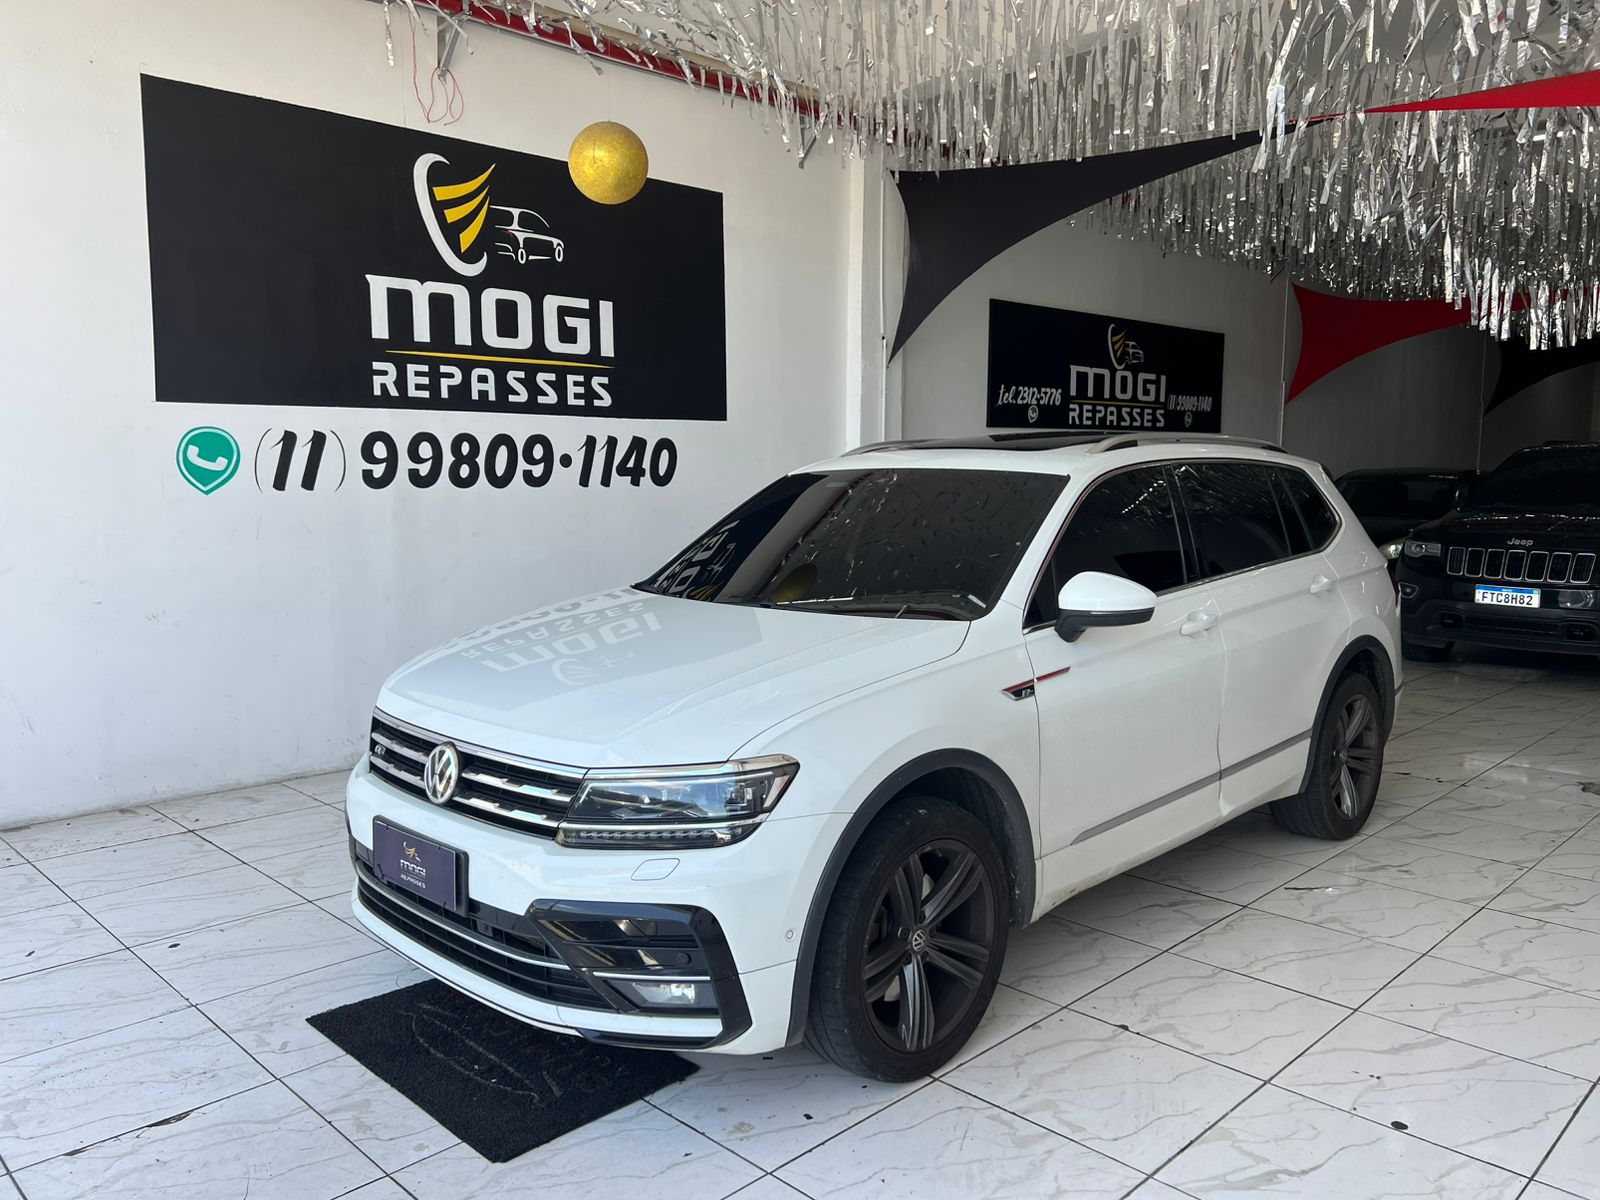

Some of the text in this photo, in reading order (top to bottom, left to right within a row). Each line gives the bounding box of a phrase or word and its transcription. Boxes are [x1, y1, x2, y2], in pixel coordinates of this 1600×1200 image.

[365, 274, 615, 358] MOGI
[371, 361, 613, 408] REPASSES
[996, 384, 1016, 407] tel.
[1069, 365, 1167, 403] MOGI
[1069, 404, 1165, 428] REPASSES
[254, 428, 346, 492] (11)
[1507, 538, 1533, 547] Jeep
[1481, 591, 1533, 606] FTC8H82
